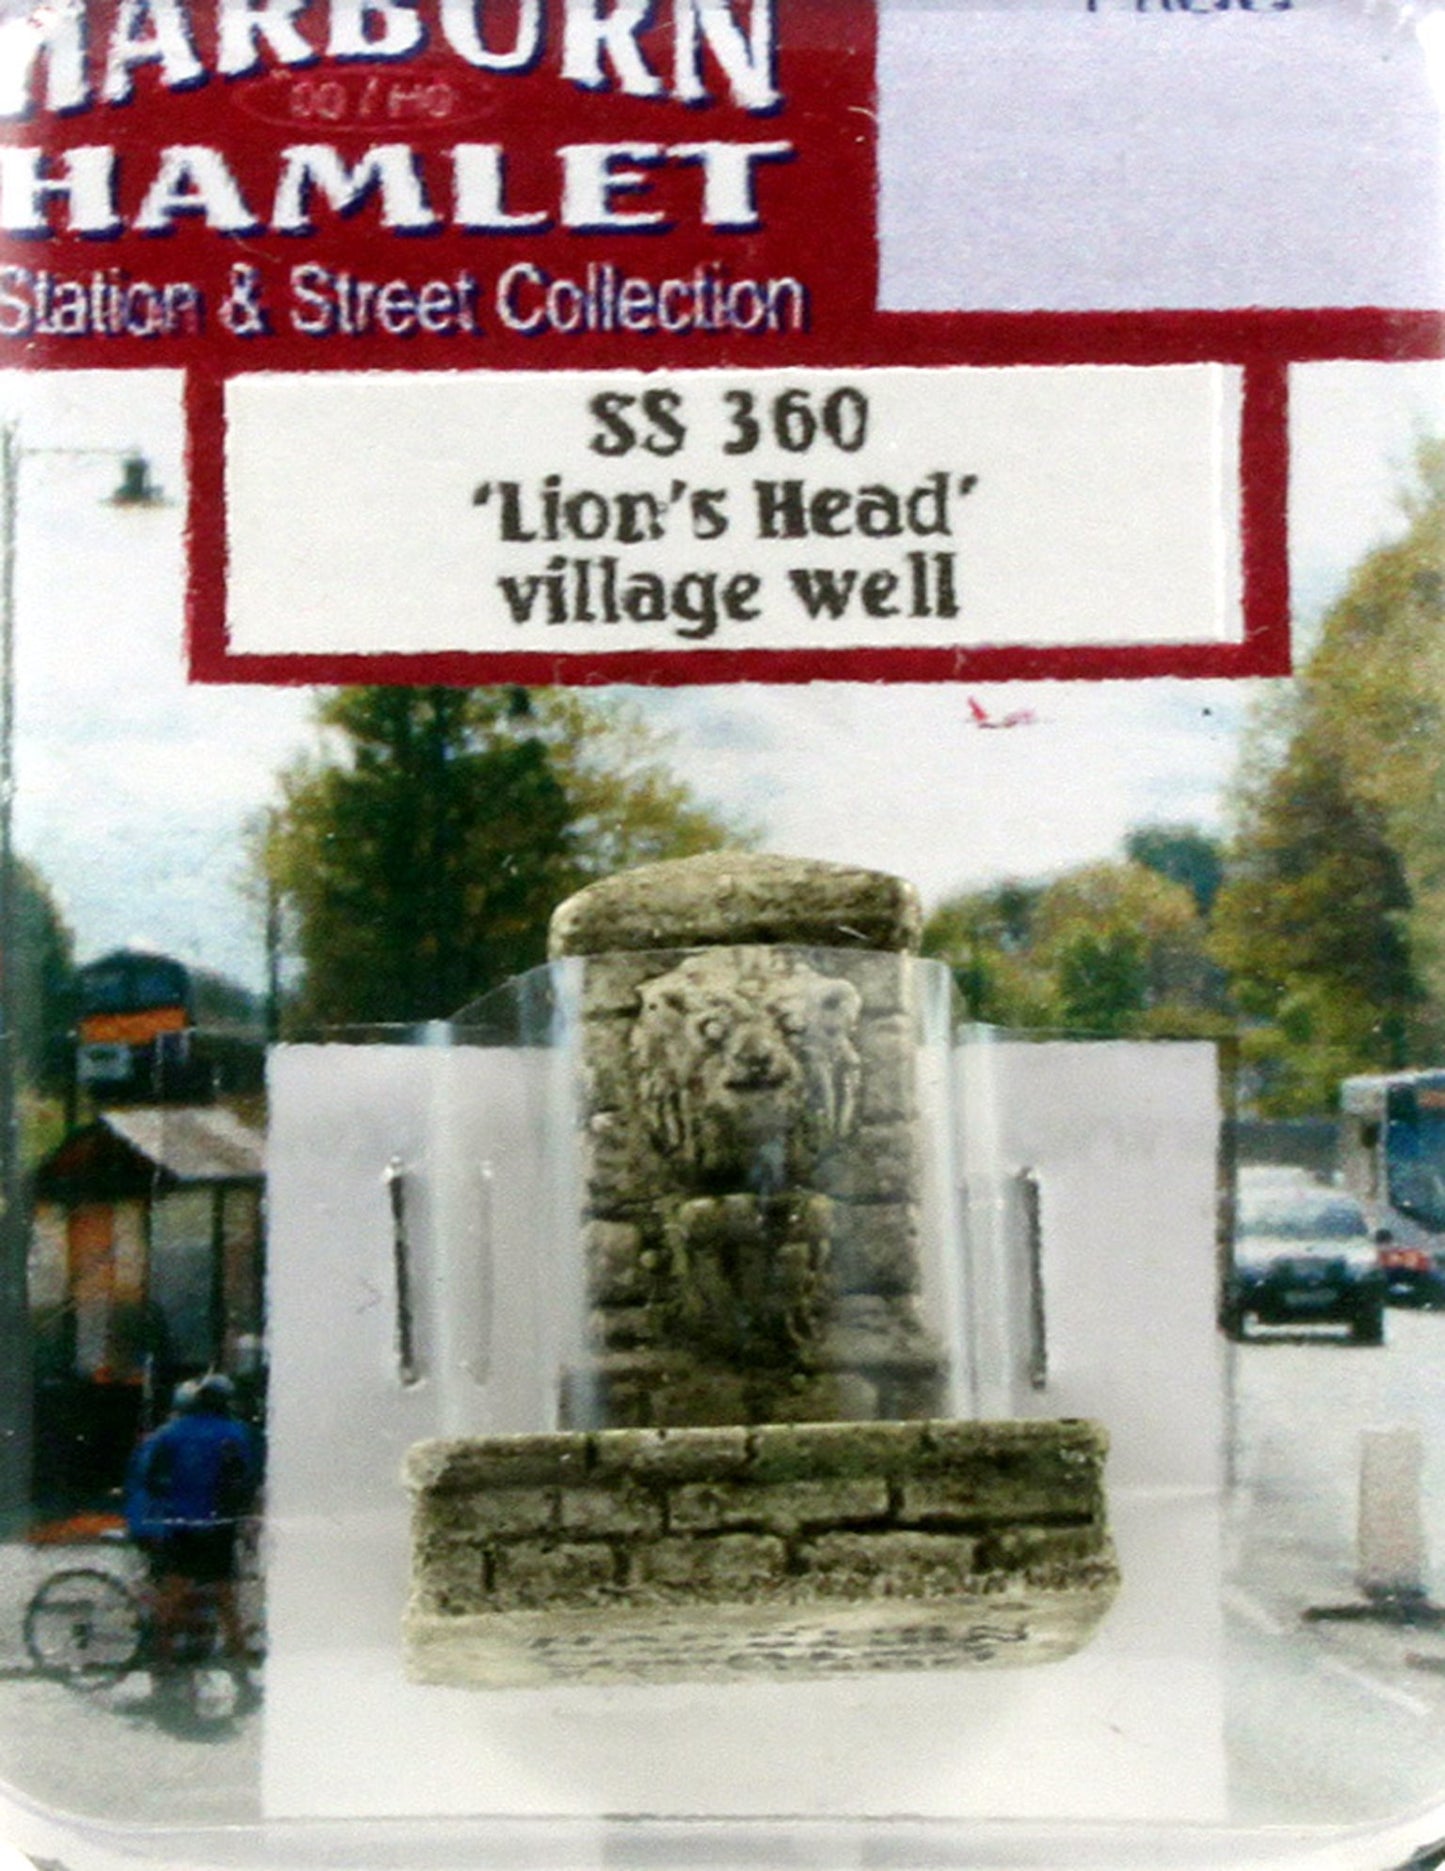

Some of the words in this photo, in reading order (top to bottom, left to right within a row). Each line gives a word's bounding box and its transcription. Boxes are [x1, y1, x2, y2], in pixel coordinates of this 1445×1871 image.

[0, 140, 795, 236] HAMLET
[0, 263, 201, 336] Station
[222, 262, 268, 335] &
[289, 261, 480, 335] Street
[496, 261, 808, 333] Collection
[588, 387, 688, 457] SS
[722, 385, 870, 456] 360
[753, 471, 980, 540] Head'
[497, 554, 762, 640] village
[789, 550, 961, 620] well
